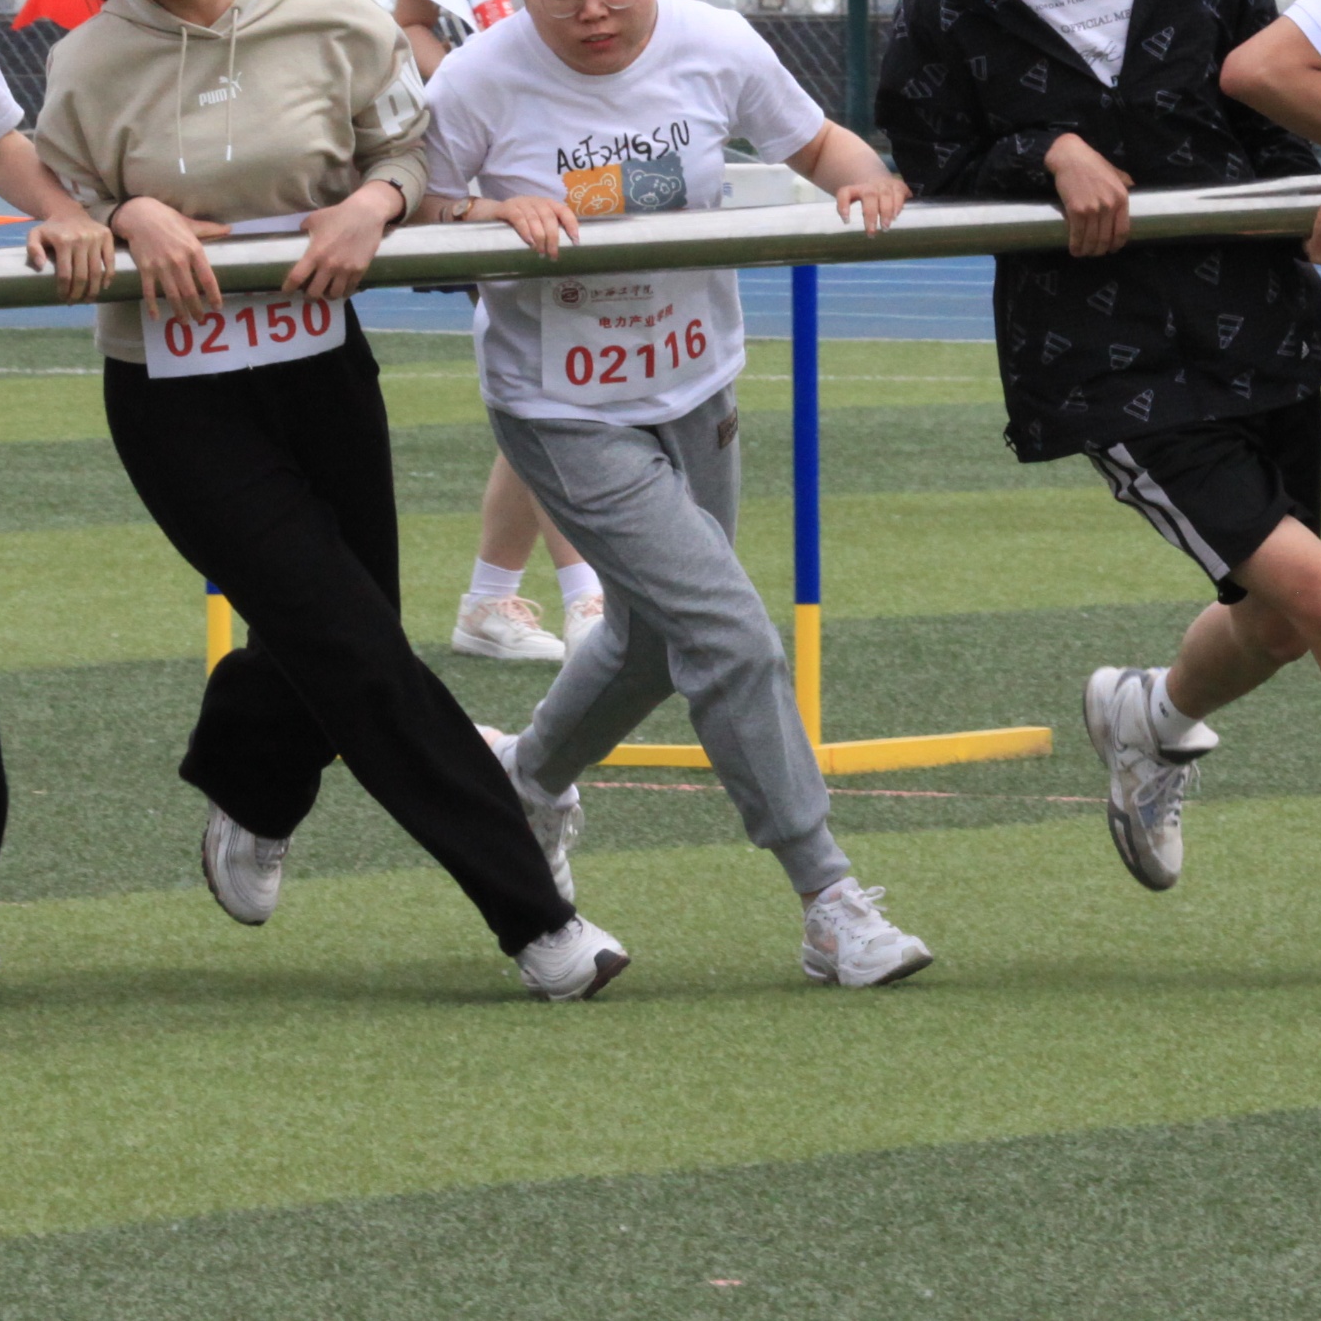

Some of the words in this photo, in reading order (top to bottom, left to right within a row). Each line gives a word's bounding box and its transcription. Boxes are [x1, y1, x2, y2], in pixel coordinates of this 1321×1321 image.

[1060, 16, 1113, 34] OFFICIAL
[164, 298, 331, 357] 02150
[599, 303, 674, 328] 电力产业学院
[565, 318, 707, 386] 02116
